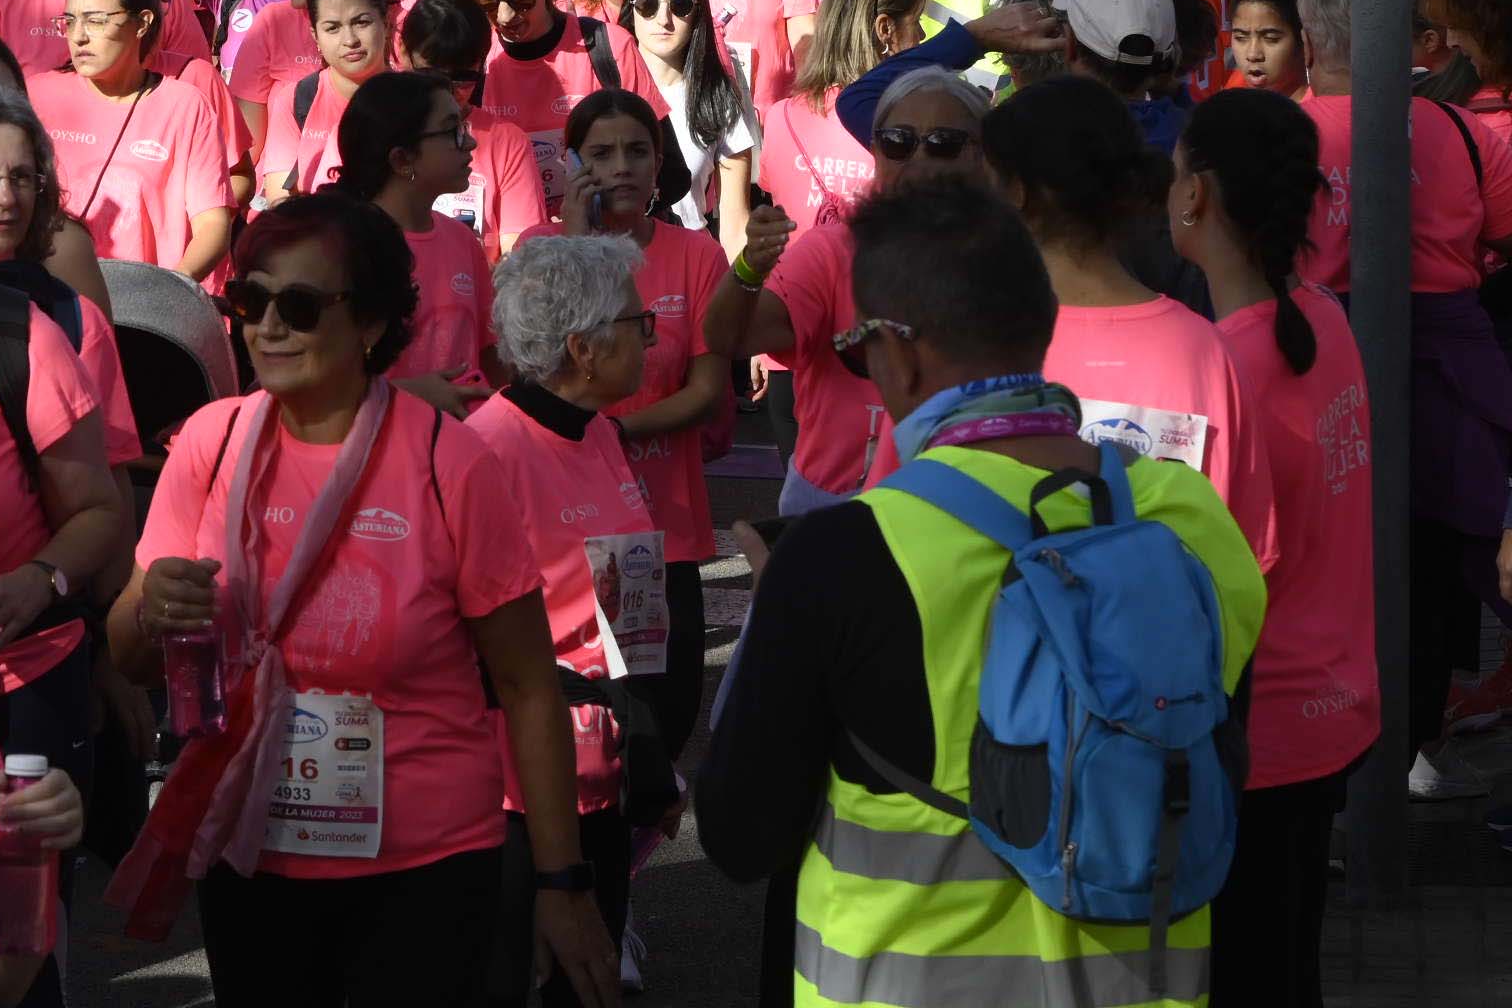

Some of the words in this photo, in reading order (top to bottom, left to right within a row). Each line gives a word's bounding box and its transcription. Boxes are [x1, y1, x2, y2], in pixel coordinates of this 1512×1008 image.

[50, 129, 97, 146] OYSHO
[335, 717, 369, 727] SUMA
[285, 808, 298, 817] LA
[300, 809, 336, 820] MUJER
[310, 830, 368, 845] Santander
